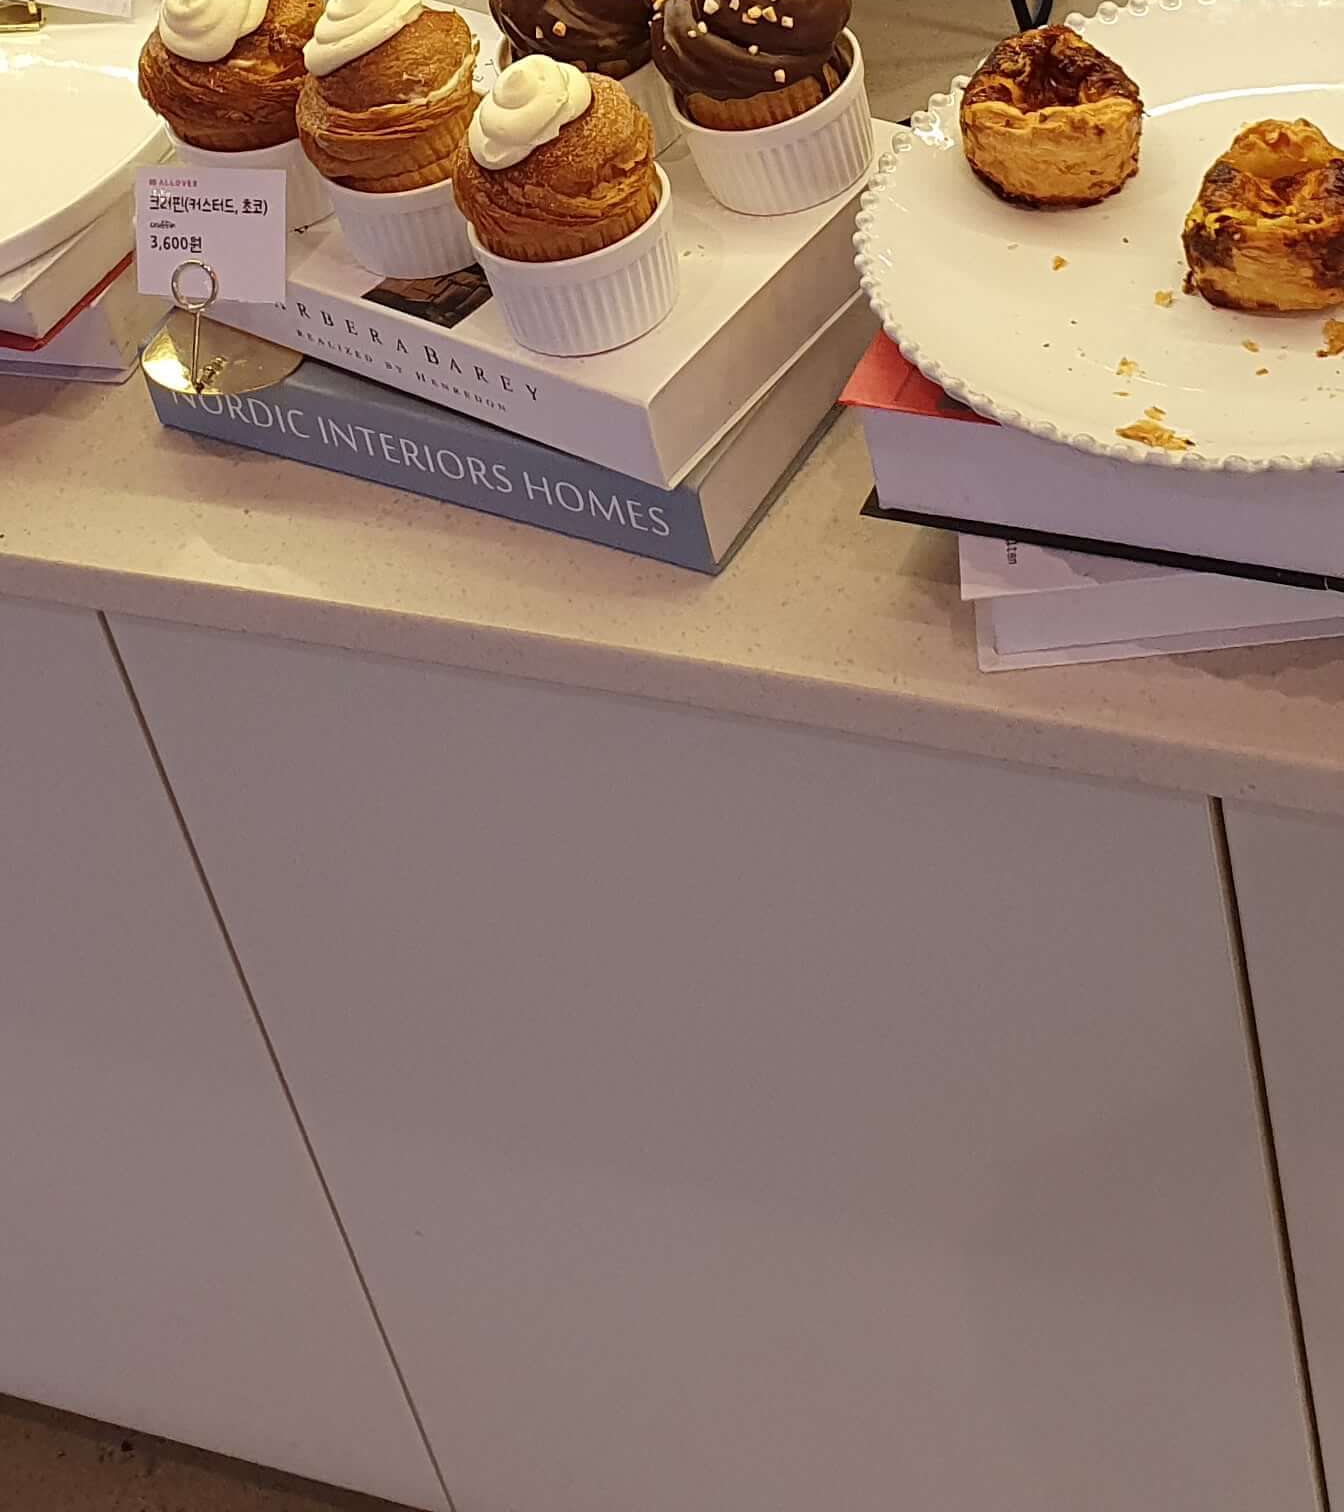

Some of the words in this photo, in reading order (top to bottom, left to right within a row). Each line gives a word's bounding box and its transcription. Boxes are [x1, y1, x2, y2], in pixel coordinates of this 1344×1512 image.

[158, 179, 198, 188] ALLOVER
[241, 198, 268, 216] 초코)
[149, 234, 202, 254] 3,600원
[171, 391, 310, 439] NORDIC
[317, 415, 513, 494] INTERIORS
[522, 471, 671, 537] HOMES
